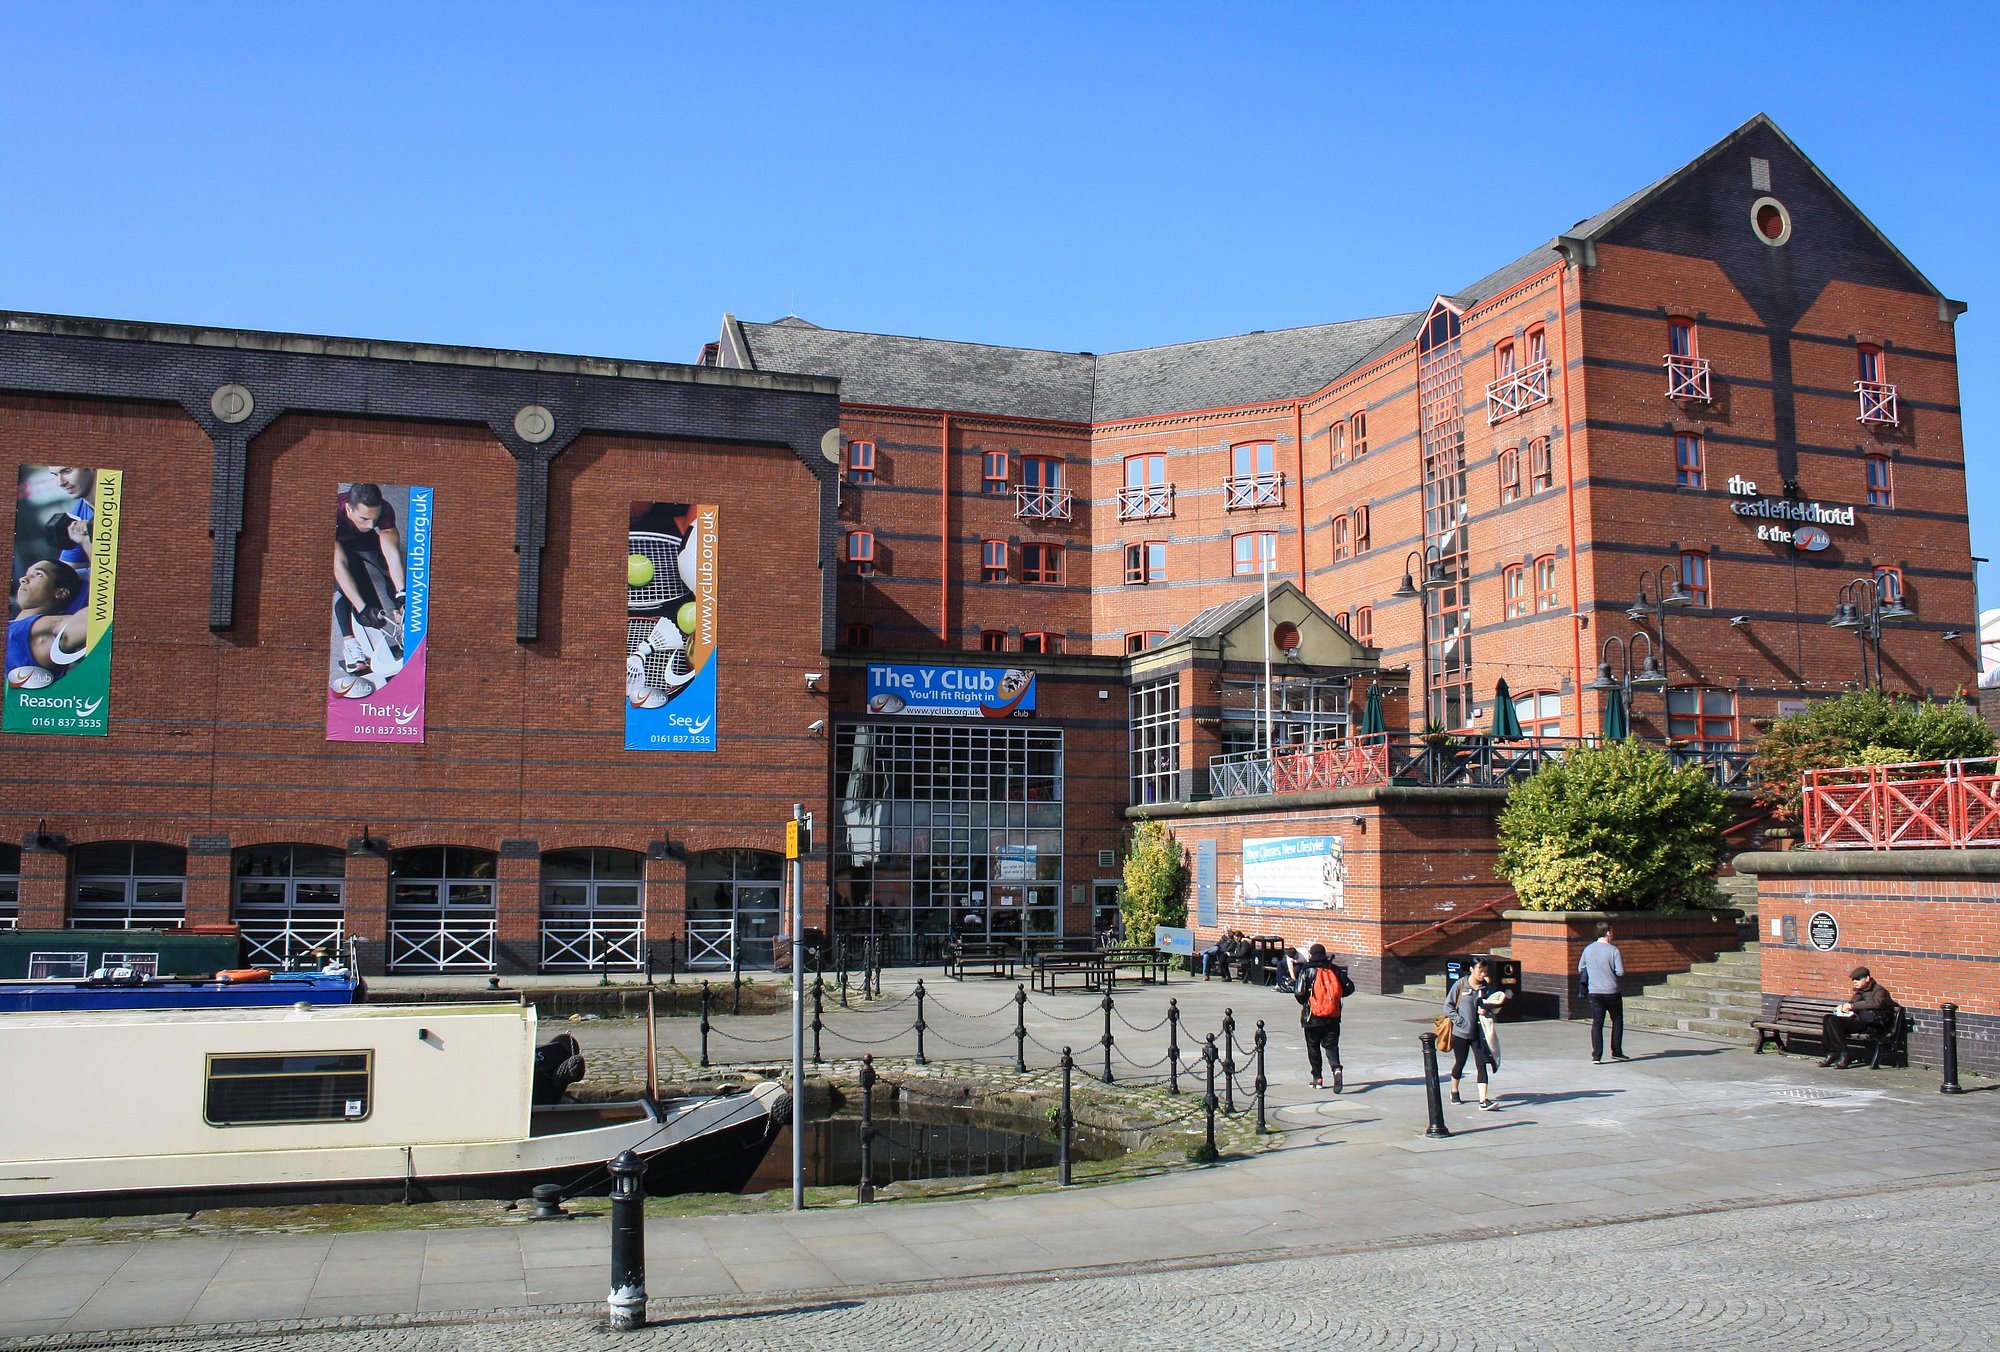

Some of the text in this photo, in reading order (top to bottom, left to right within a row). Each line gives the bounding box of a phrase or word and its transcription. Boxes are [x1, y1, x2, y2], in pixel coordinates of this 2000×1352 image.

[1728, 475, 1757, 496] the
[1757, 525, 1769, 540] &
[1769, 526, 1792, 543] the
[95, 477, 118, 622] www.yclub.org.uk
[410, 493, 430, 633] www.yclub.org.uk
[699, 511, 717, 646] www.yclub.org.uk
[32, 673, 52, 683] club
[871, 667, 995, 691] The Y Club
[355, 683, 372, 693] club
[19, 694, 83, 709] Reason's
[649, 693, 667, 703] club
[909, 690, 995, 703] You'll fit Right in
[360, 703, 402, 717] That's
[906, 706, 980, 716] www.yclub.org.uk
[1013, 710, 1029, 718] club
[32, 717, 102, 728] 0161 837 3535
[669, 714, 693, 727] See
[354, 725, 418, 735] 0161 837 3535
[650, 734, 711, 744] 0161 837 3535
[1282, 843, 1297, 854] New
